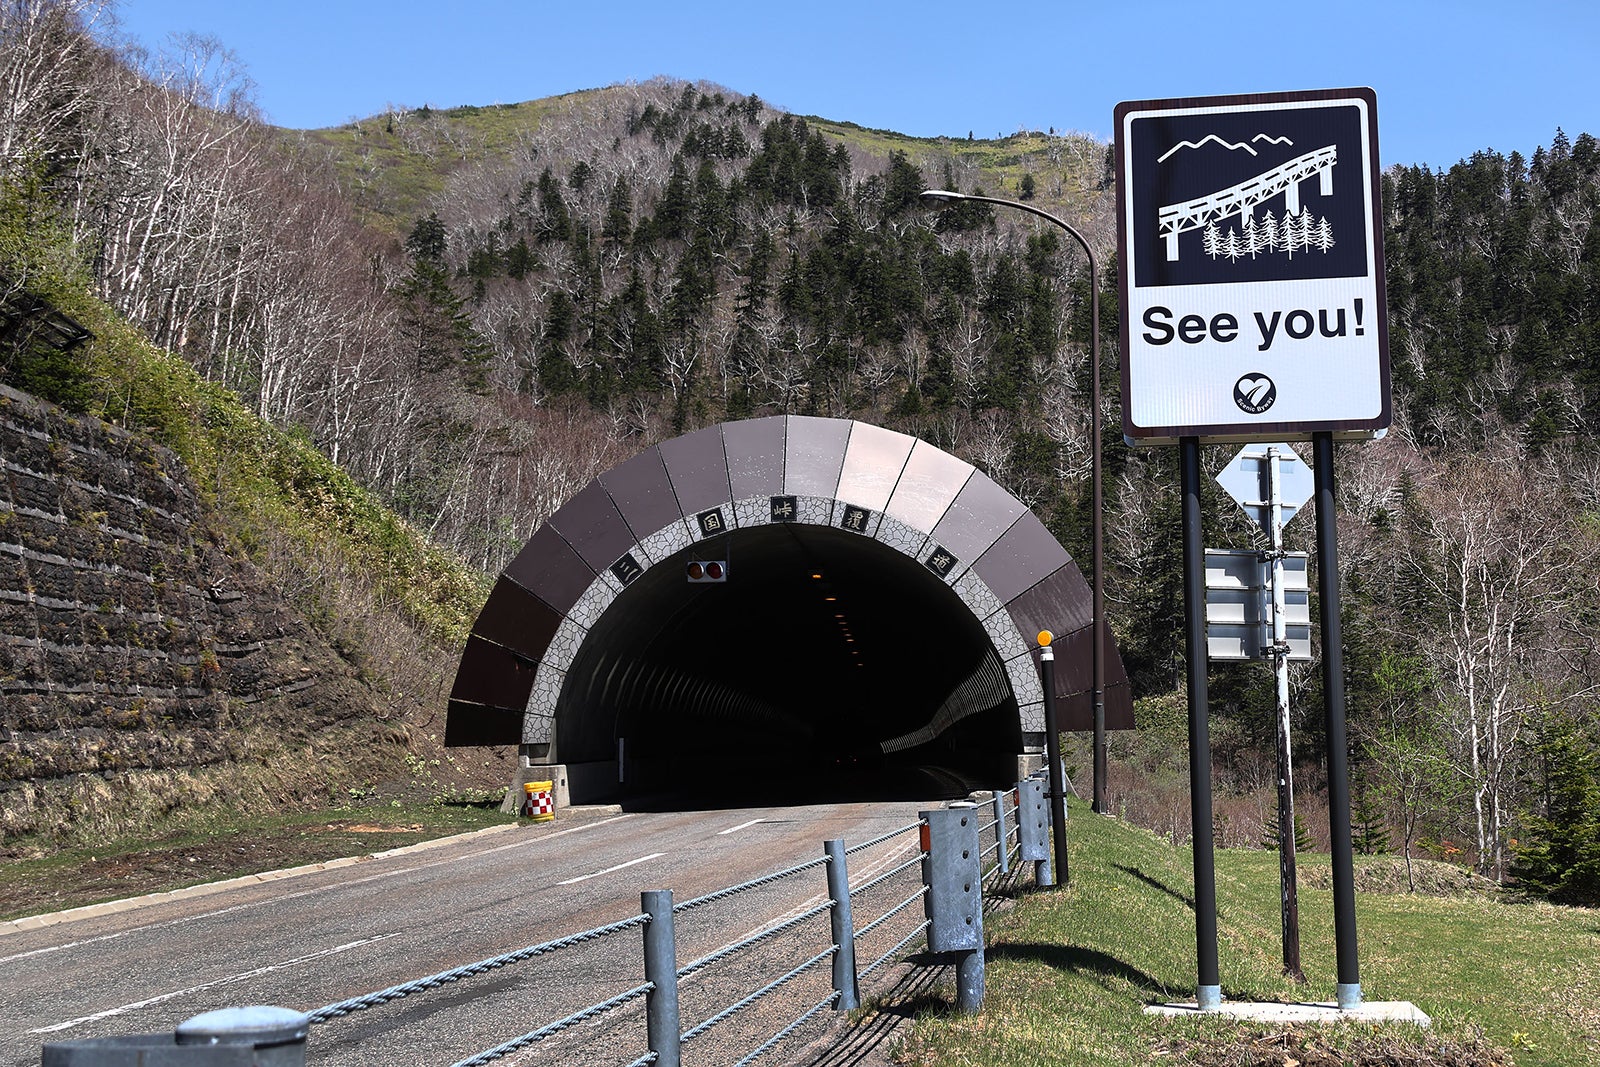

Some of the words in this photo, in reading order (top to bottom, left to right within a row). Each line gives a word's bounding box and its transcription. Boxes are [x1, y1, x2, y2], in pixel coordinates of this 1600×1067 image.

[1142, 306, 1239, 346] See
[1253, 298, 1365, 351] you!
[1236, 397, 1256, 413] Scenic
[1256, 396, 1274, 412] Byway
